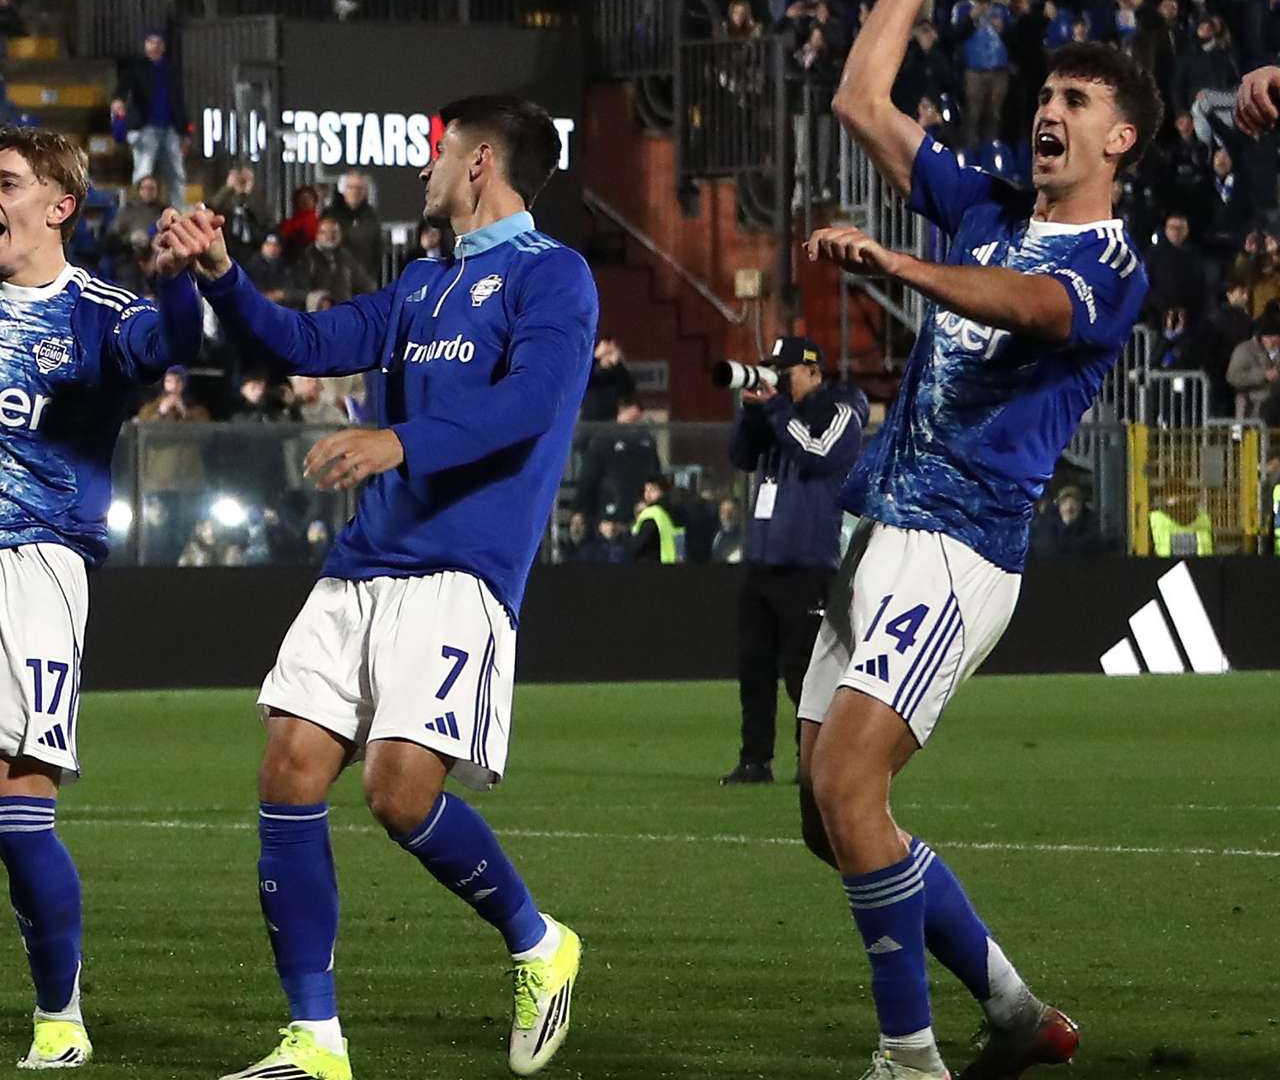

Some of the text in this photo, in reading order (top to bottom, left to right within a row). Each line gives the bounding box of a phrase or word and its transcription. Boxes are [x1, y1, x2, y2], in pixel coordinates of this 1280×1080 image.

[863, 594, 930, 655] 14
[25, 658, 69, 715] 17
[435, 645, 469, 700] 7
